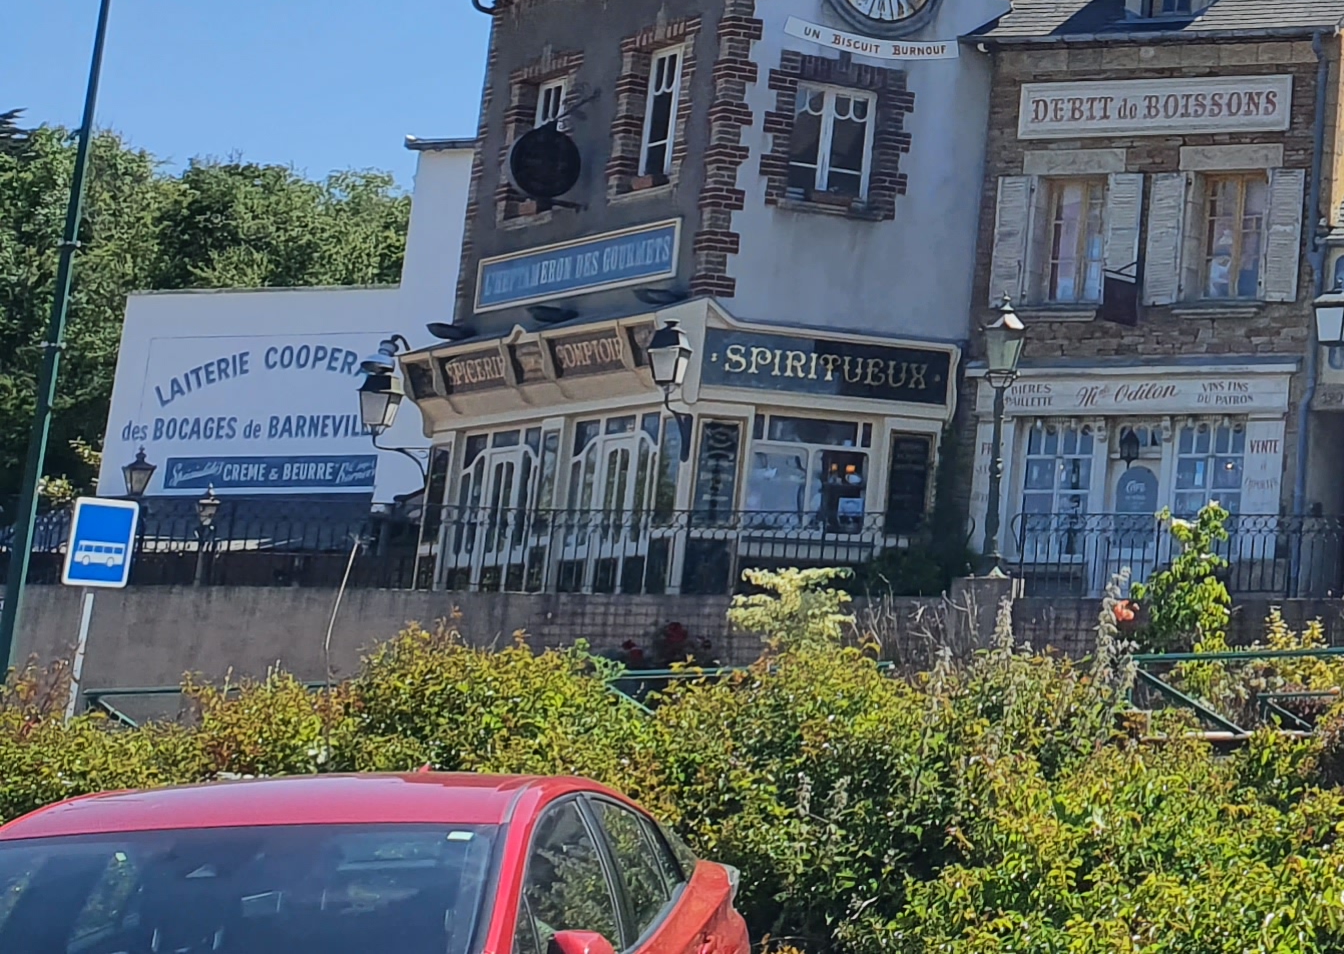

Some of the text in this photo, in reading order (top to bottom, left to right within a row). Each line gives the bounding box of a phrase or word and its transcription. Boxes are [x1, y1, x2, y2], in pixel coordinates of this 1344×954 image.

[804, 26, 946, 56] UN BISCUIT BURNOUF
[1030, 90, 1278, 123] DEBIT de BOISSONS
[575, 251, 599, 279] DES
[602, 235, 671, 272] GOURMETS
[155, 351, 250, 407] LAITERIE
[724, 345, 928, 390] SPIRITUEUX
[1114, 382, 1178, 403] Odilon
[122, 420, 148, 441] des
[152, 417, 237, 440] BOCAGES
[243, 419, 261, 439] de
[1250, 439, 1280, 454] VENTE
[222, 464, 267, 482] CREME
[269, 468, 278, 480] &
[282, 462, 333, 480] BEURRE
